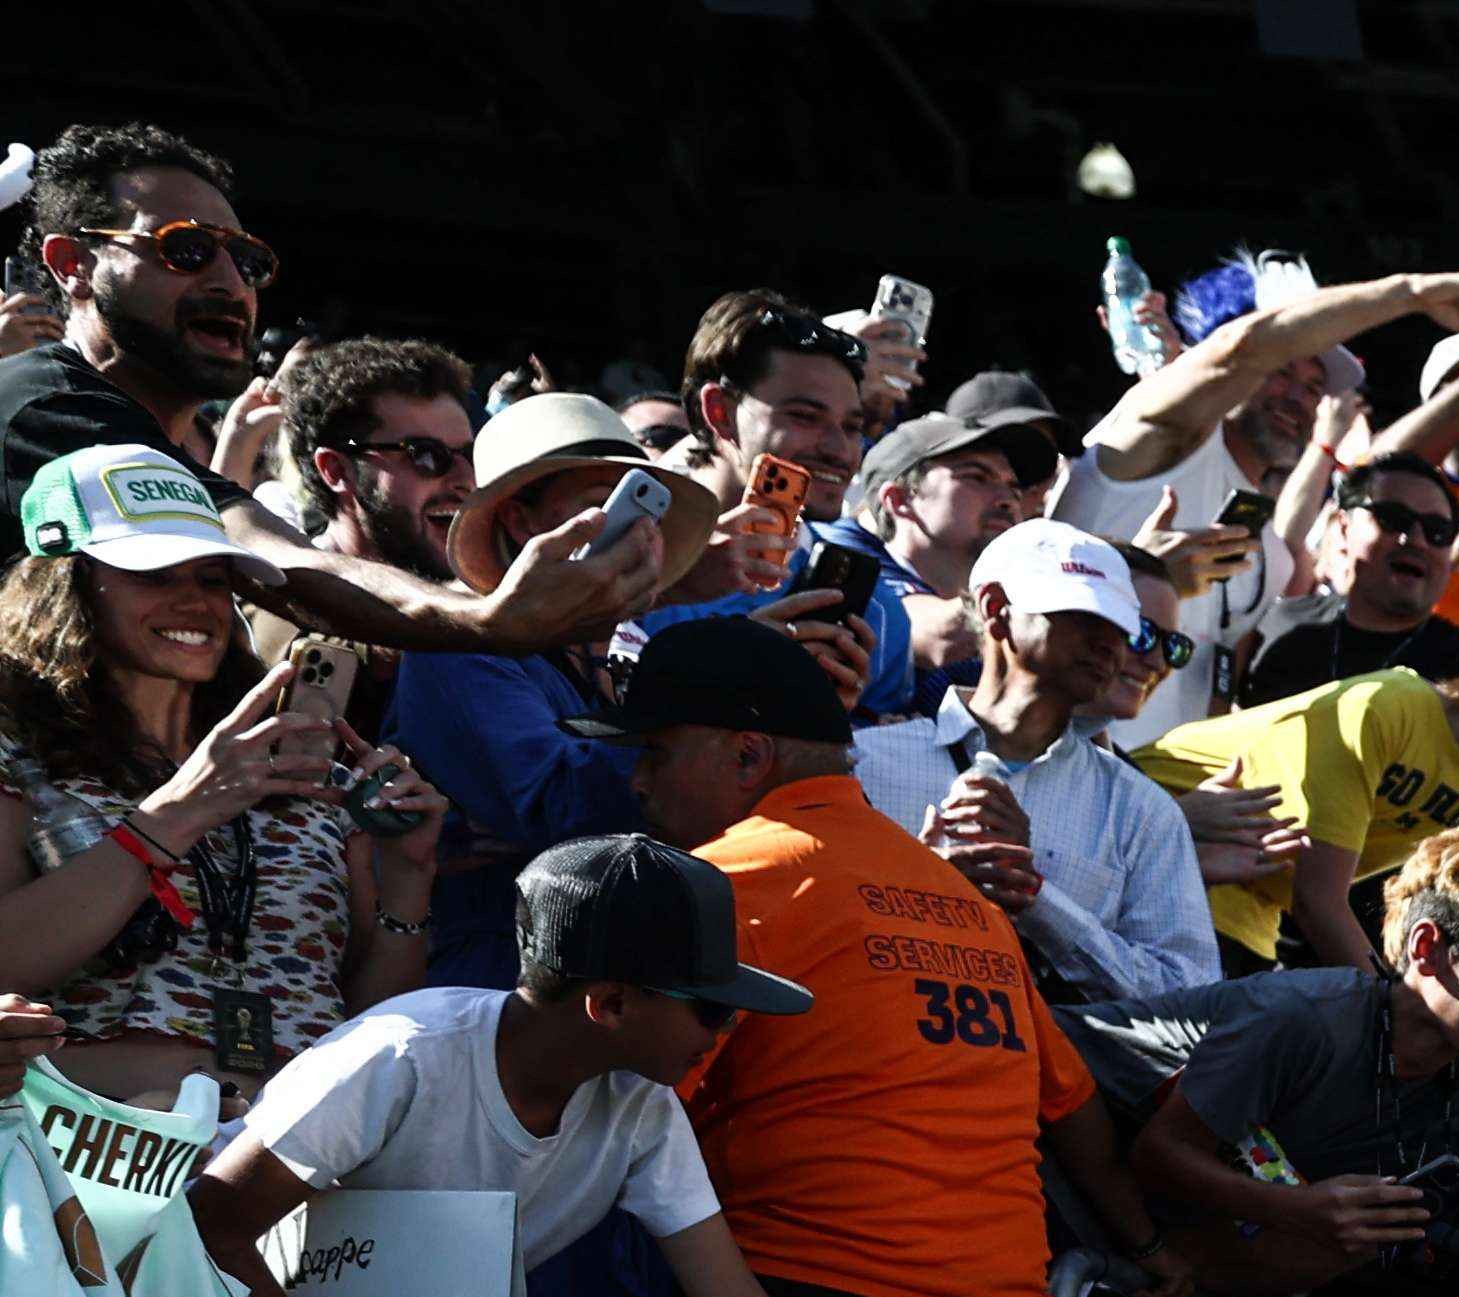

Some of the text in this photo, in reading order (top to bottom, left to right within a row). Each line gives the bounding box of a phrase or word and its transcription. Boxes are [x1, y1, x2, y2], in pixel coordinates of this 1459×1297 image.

[858, 884, 990, 933] SAFETY
[865, 935, 1021, 989] SERVICES
[914, 979, 1026, 1052] 381
[41, 1104, 199, 1198] CHERKI
